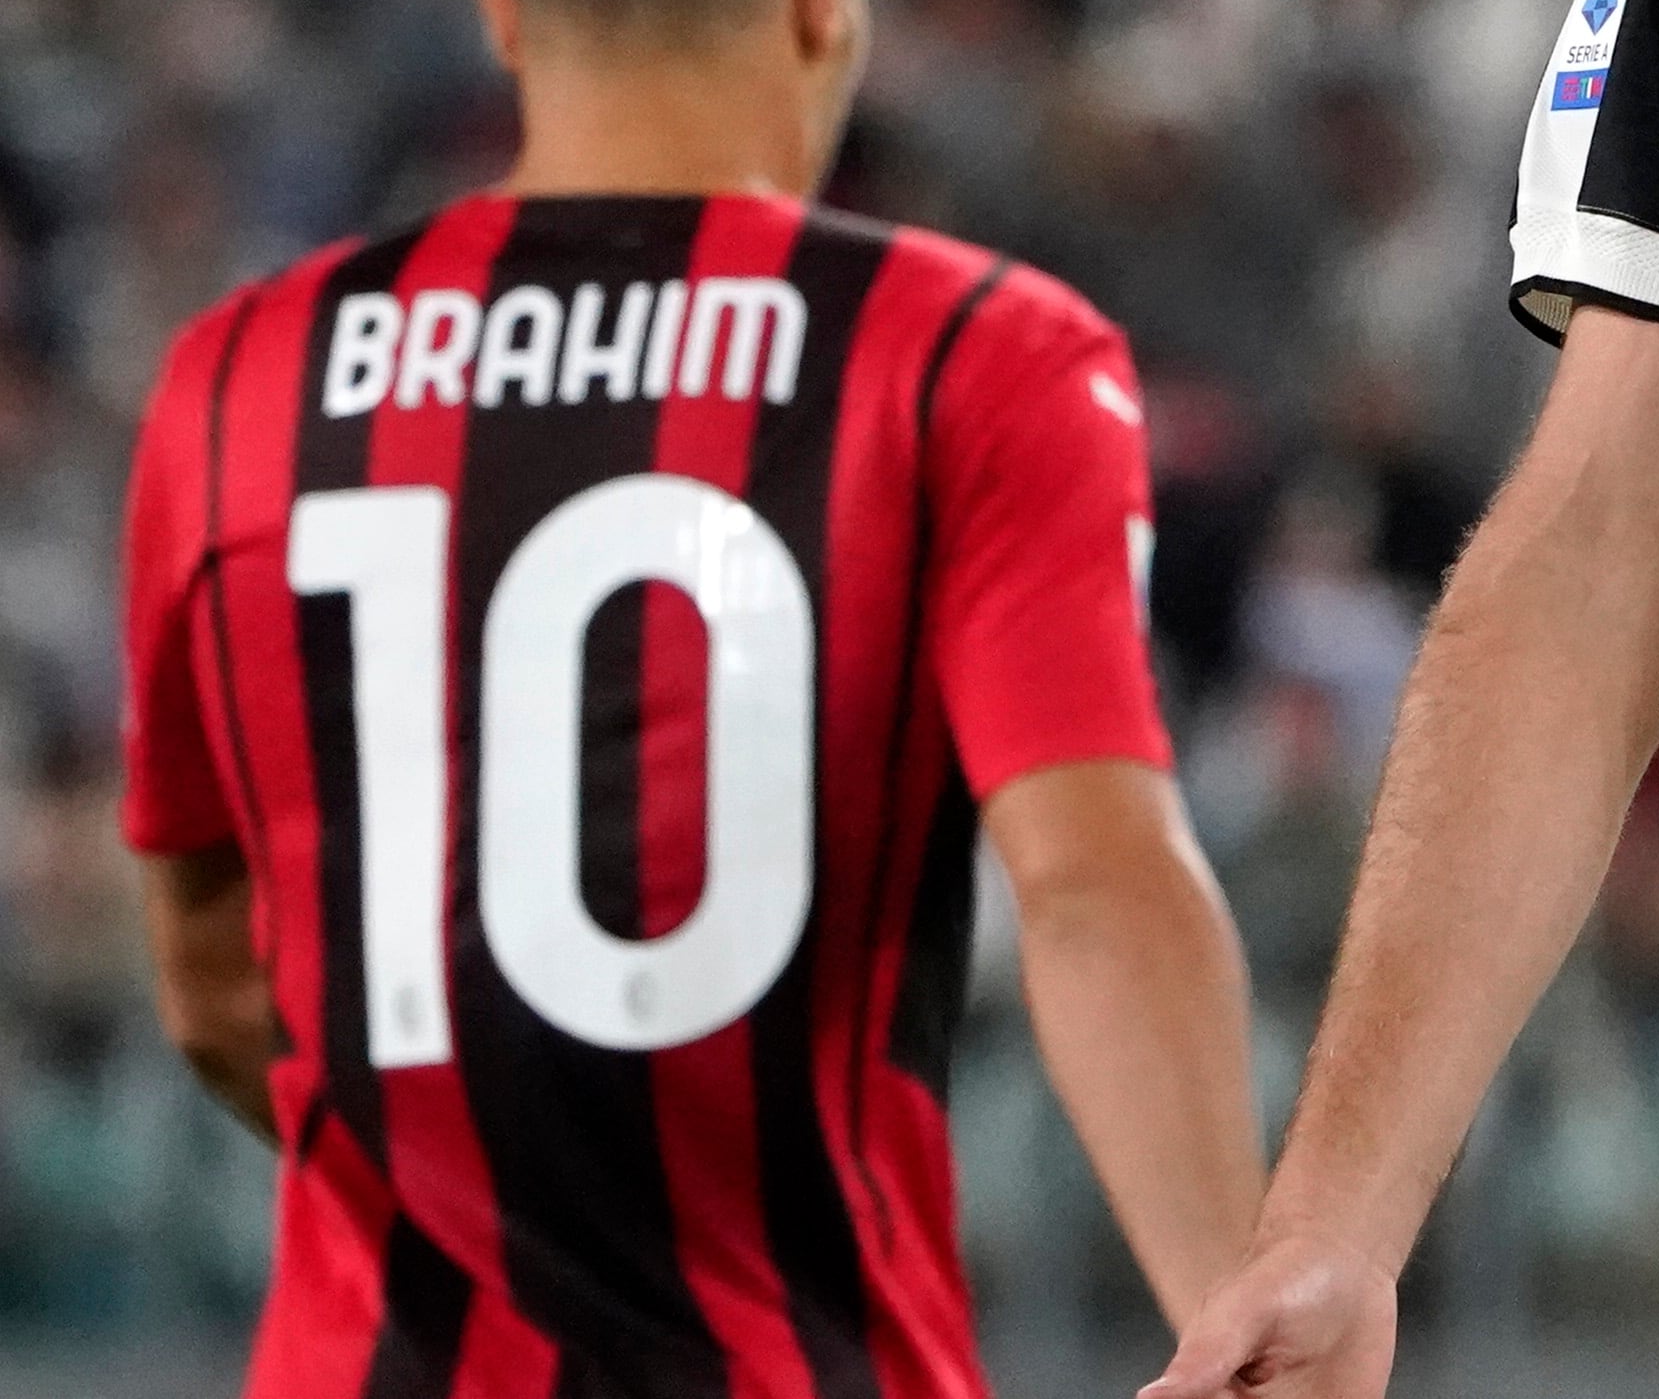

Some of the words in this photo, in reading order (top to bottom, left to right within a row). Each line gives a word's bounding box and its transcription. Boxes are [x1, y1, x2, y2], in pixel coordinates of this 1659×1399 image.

[1567, 45, 1601, 64] SERIE
[322, 276, 808, 418] BRAHIM
[286, 472, 815, 1069] 10
